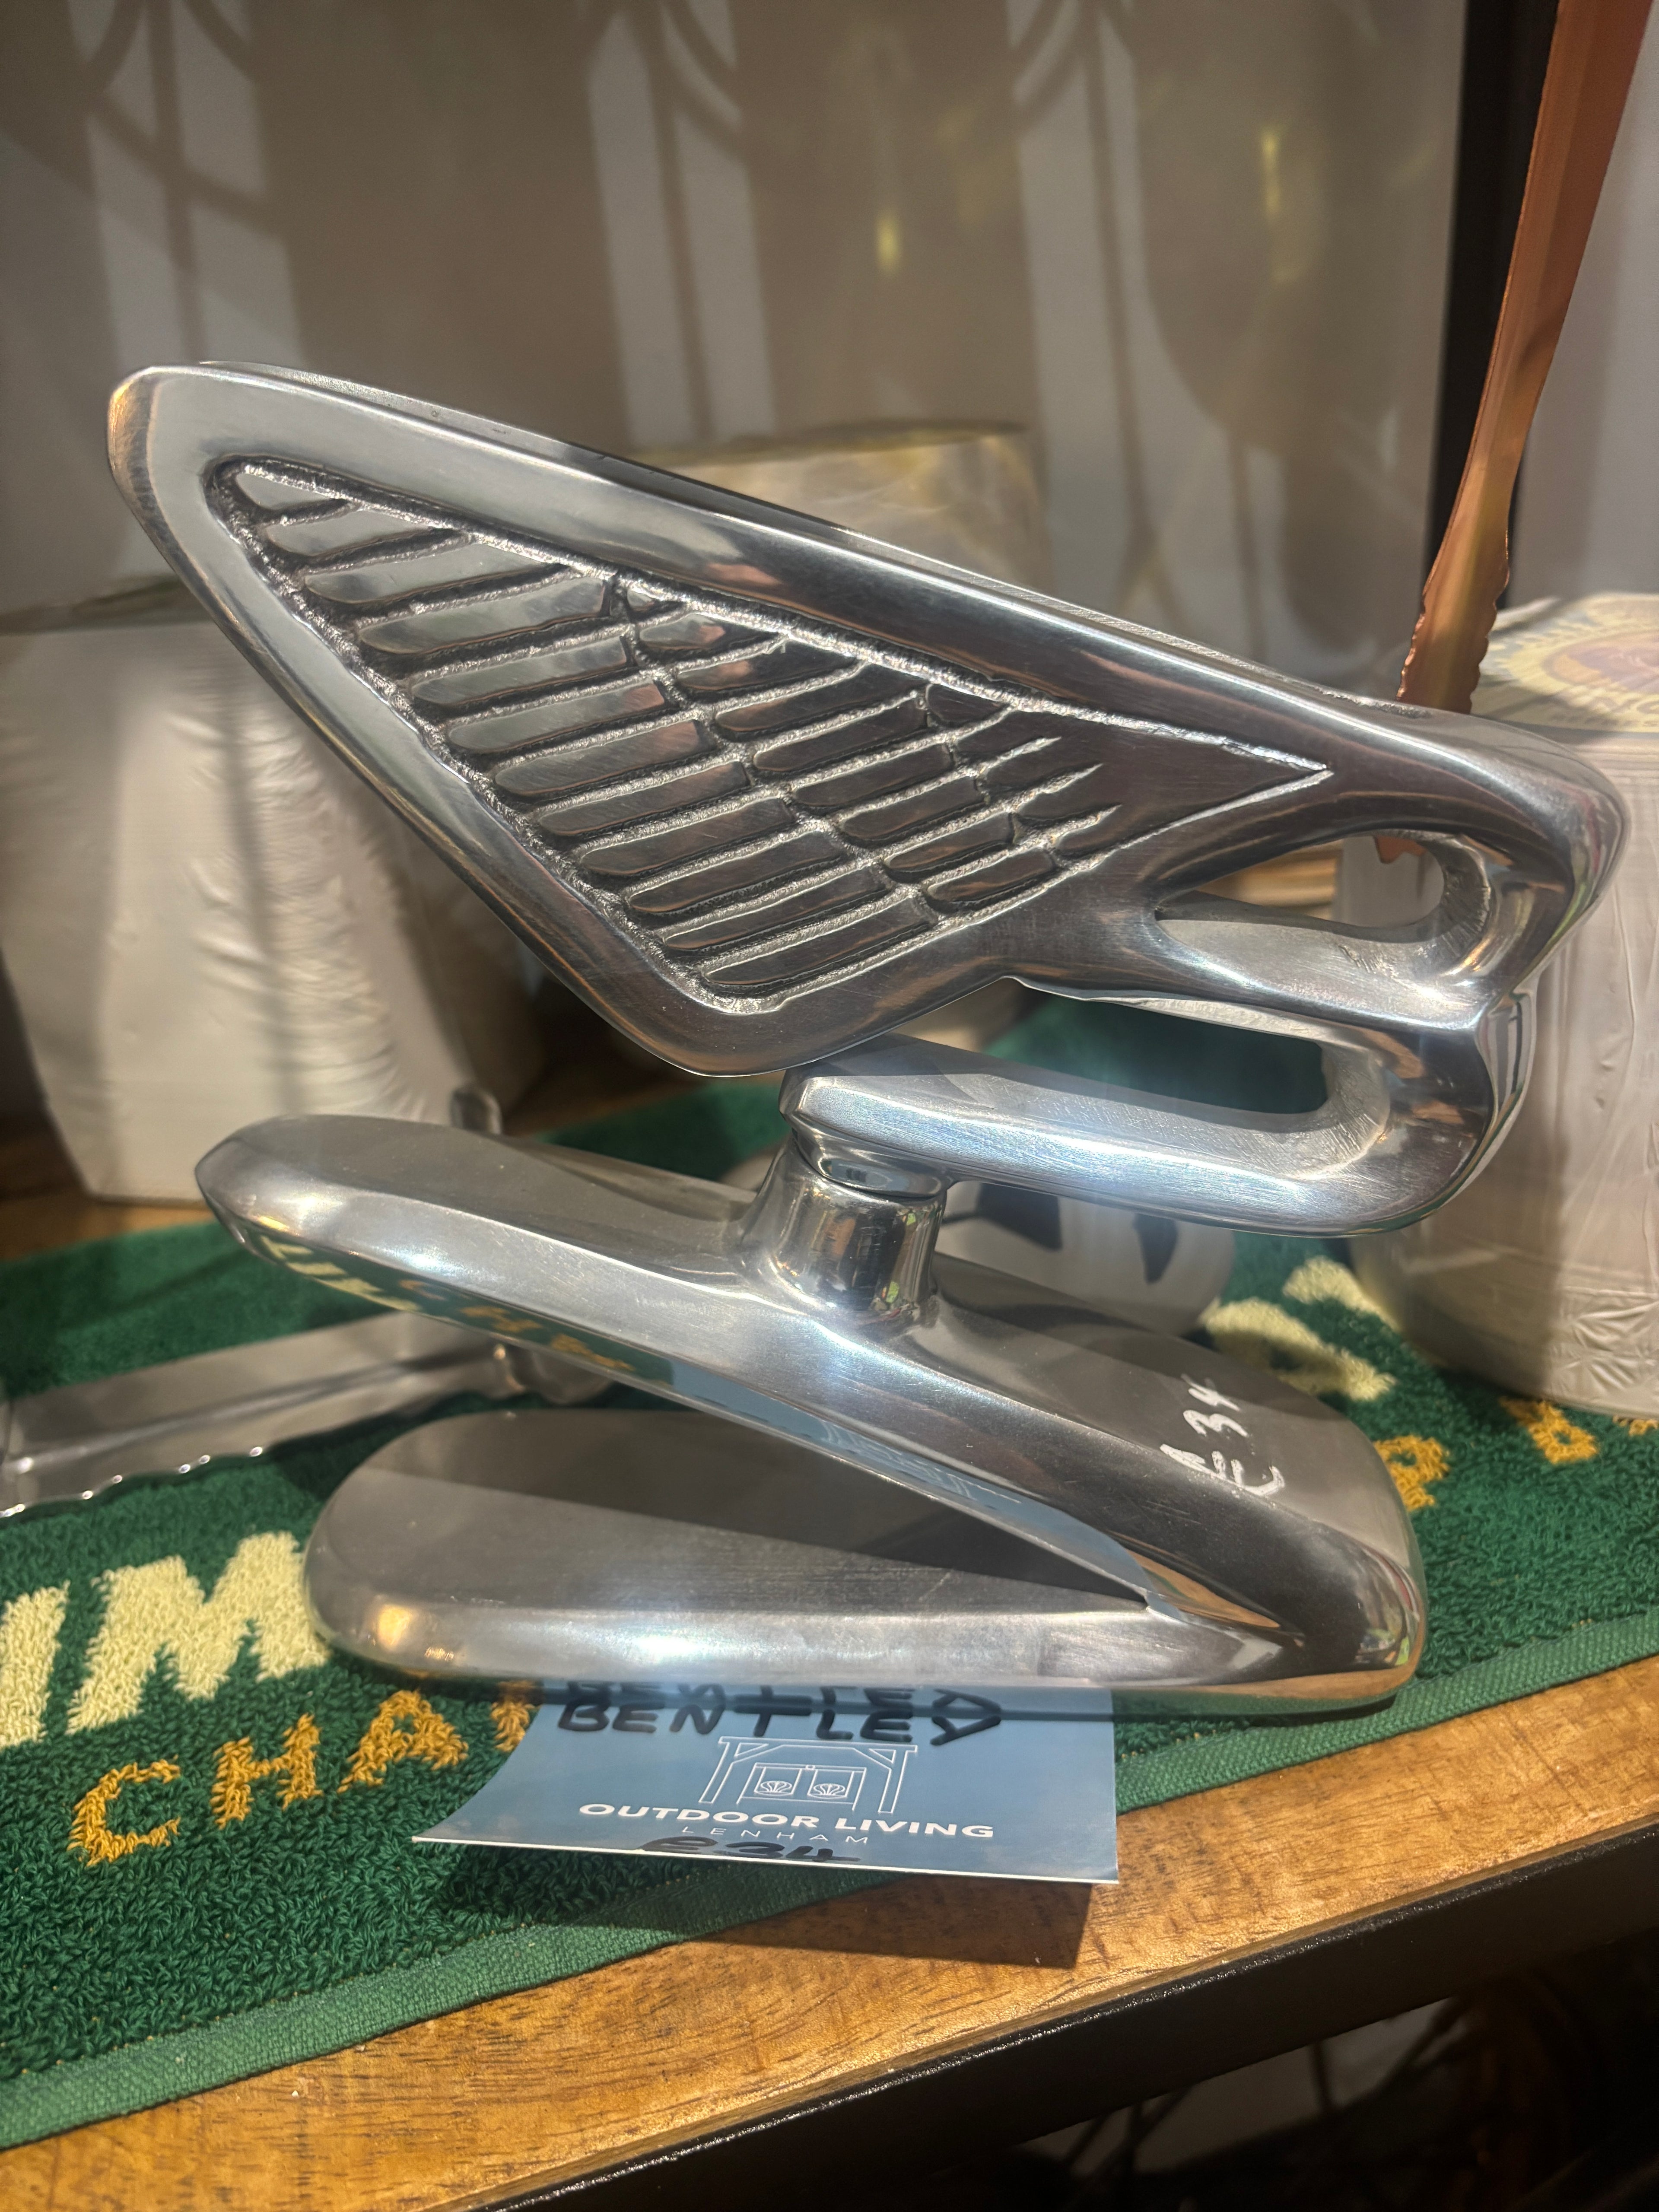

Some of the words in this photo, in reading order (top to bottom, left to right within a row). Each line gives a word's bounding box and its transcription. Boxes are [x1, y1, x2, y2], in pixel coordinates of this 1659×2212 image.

[557, 1694, 1002, 1746] BENTLEY
[579, 1803, 820, 1828] OUTDOOR
[835, 1817, 994, 1838] LIVING
[681, 1825, 869, 1844] LENHAM
